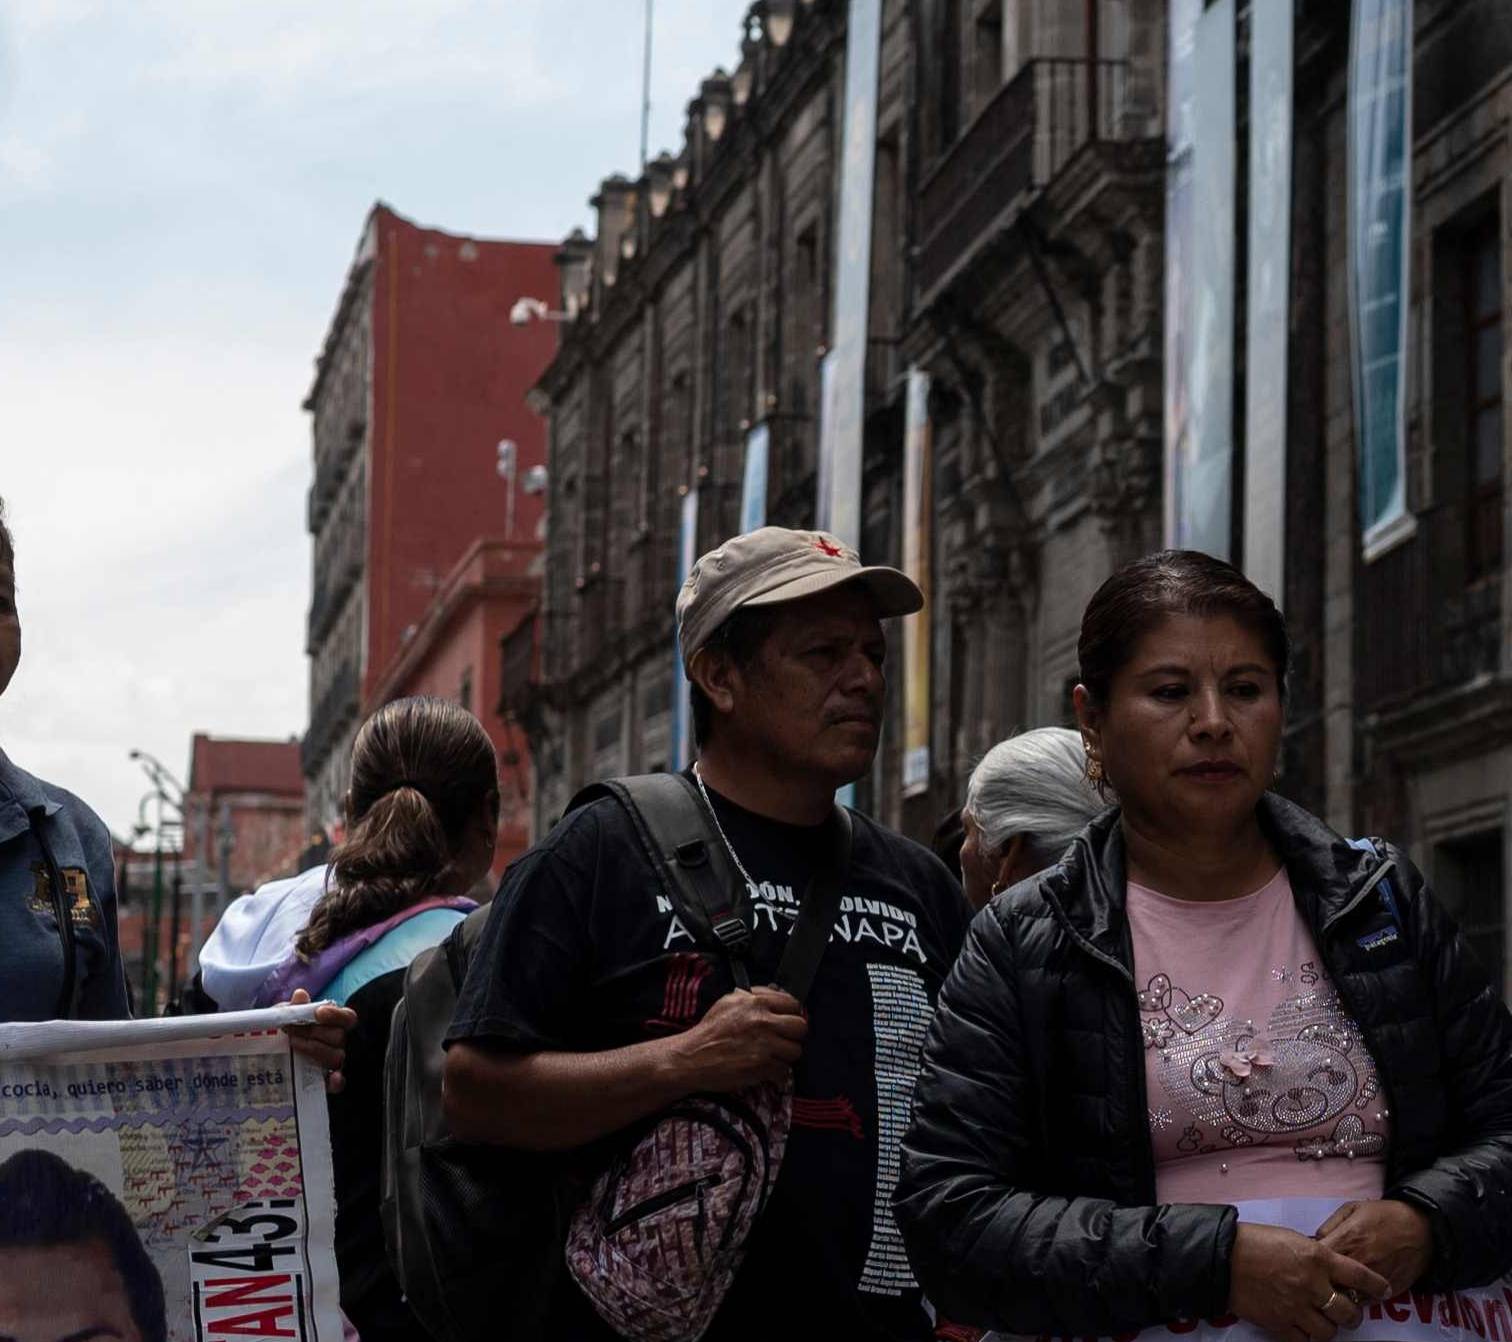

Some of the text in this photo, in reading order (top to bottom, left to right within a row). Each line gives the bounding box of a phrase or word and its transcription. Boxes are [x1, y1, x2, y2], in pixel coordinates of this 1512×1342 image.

[839, 895, 918, 928] OLVIDO
[67, 1079, 126, 1097] quiero
[135, 1075, 183, 1092] saber
[246, 1068, 284, 1086] está
